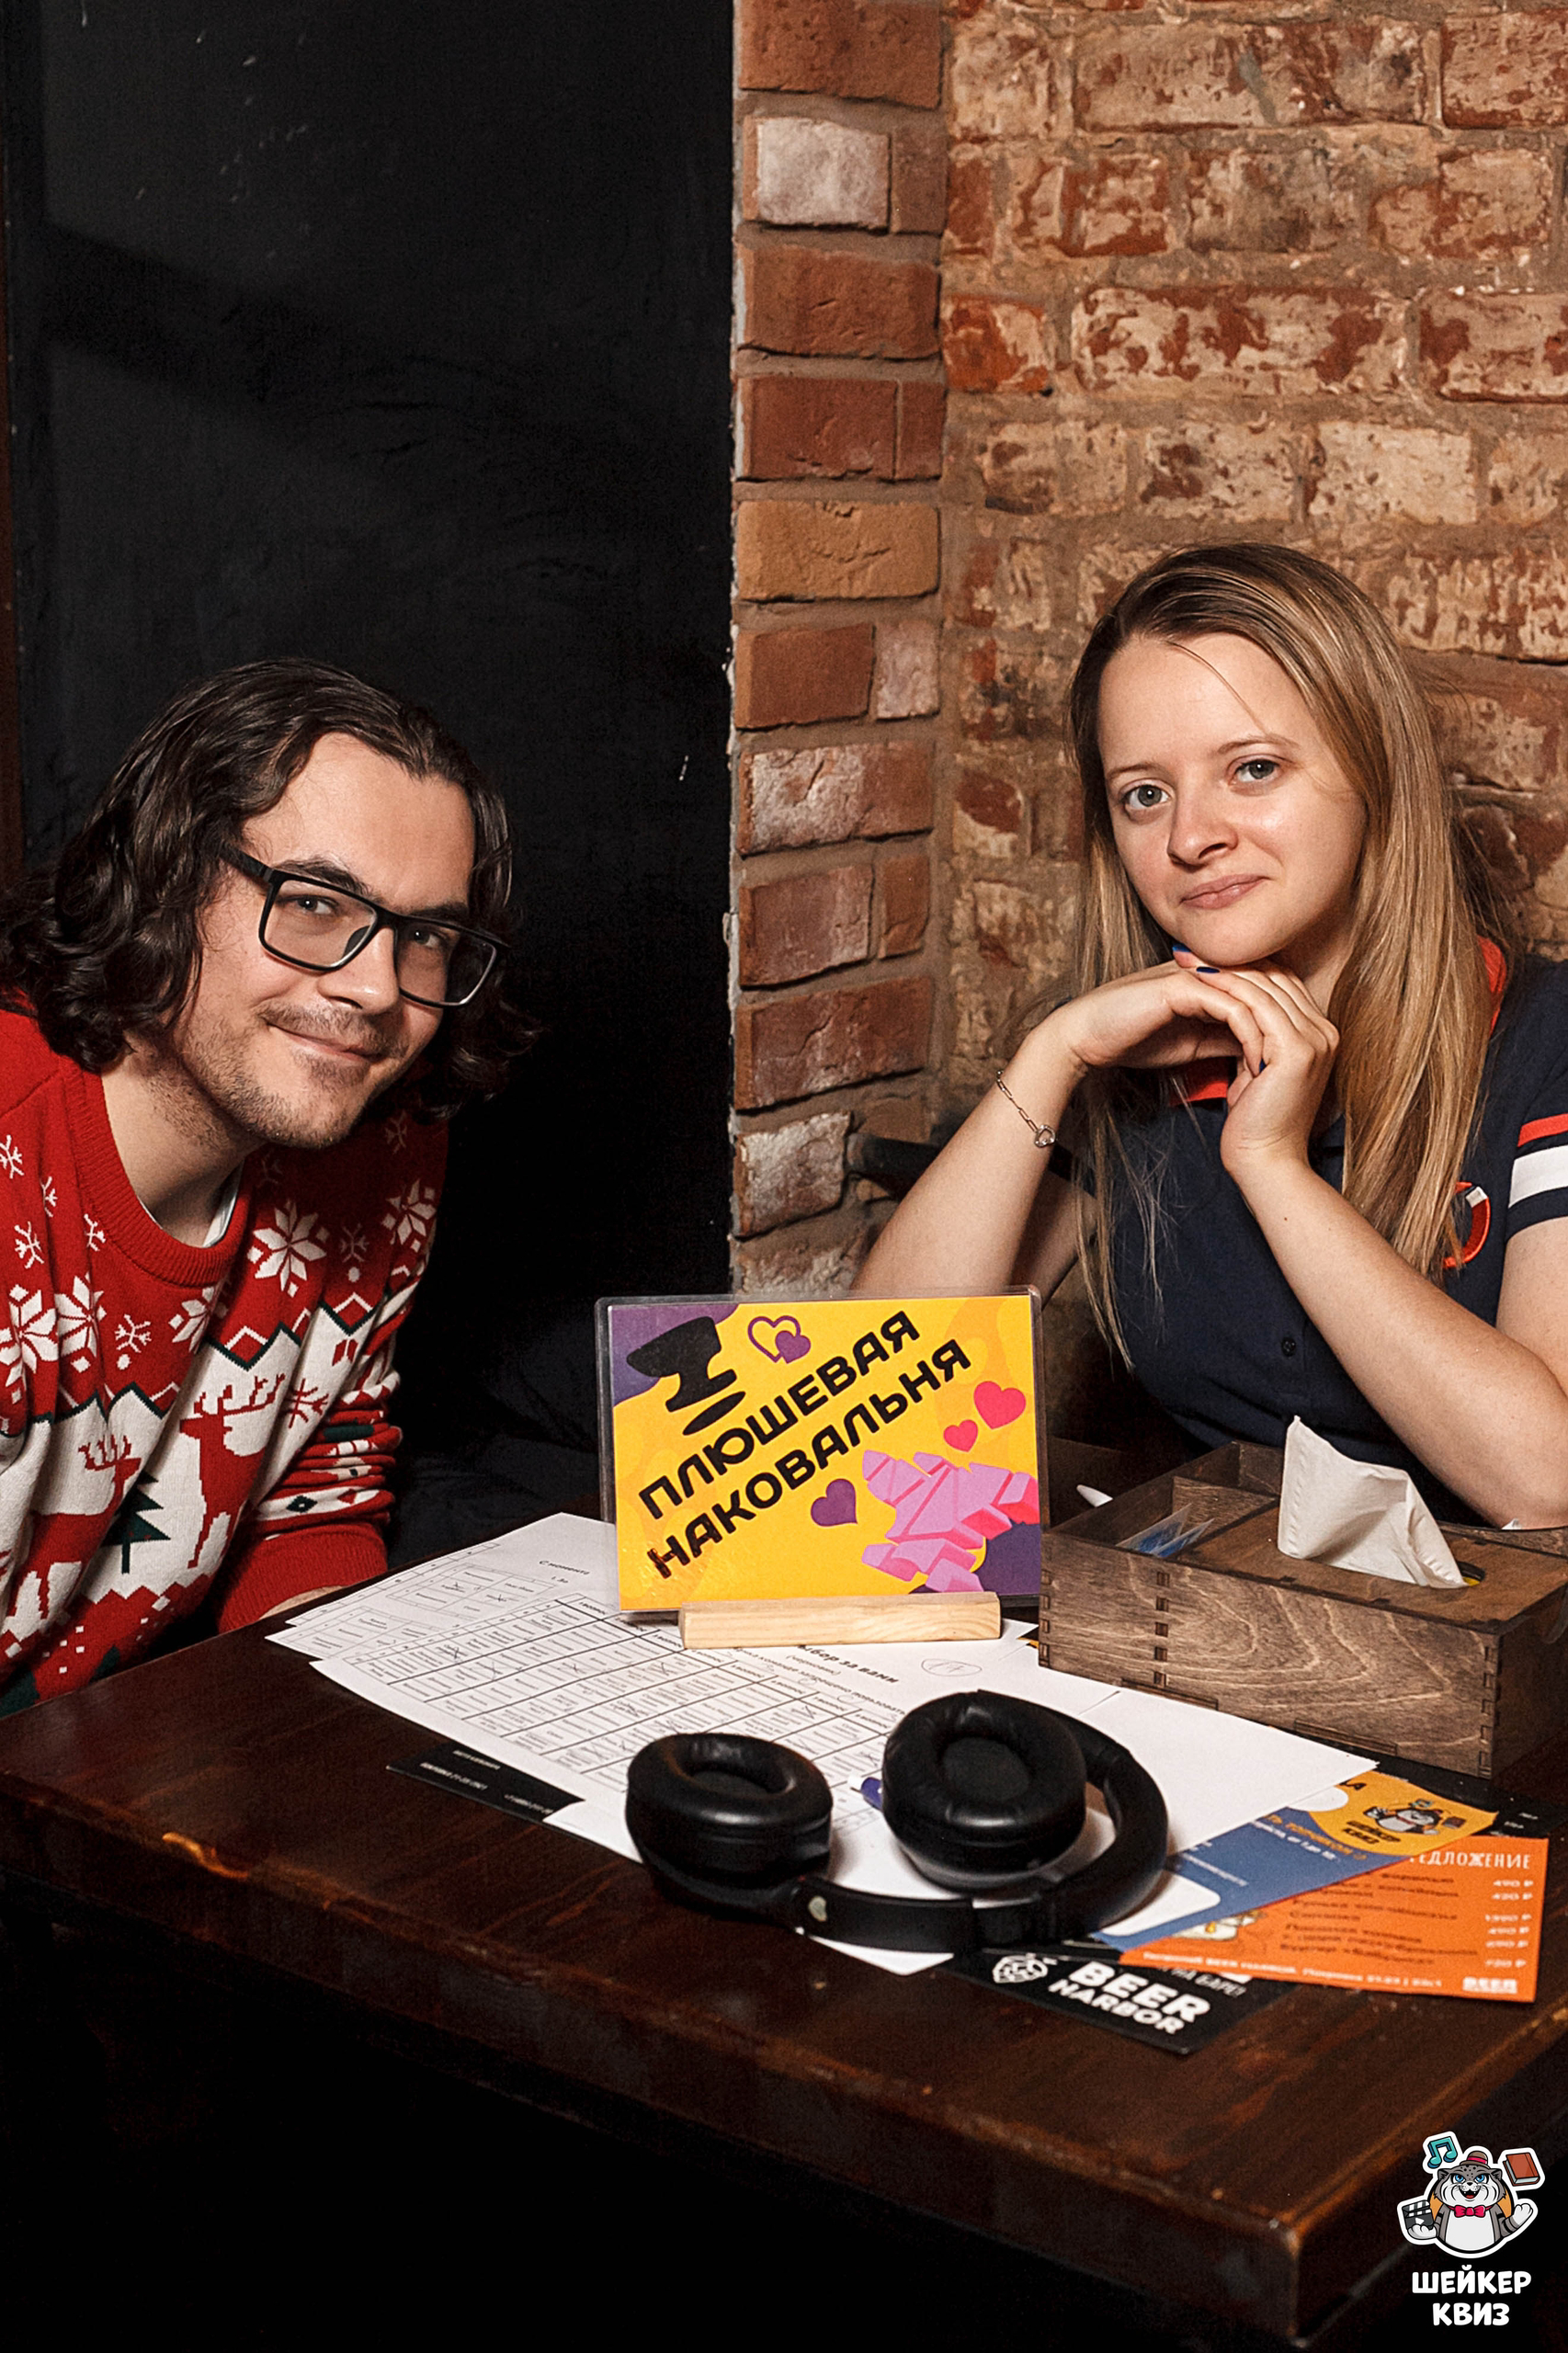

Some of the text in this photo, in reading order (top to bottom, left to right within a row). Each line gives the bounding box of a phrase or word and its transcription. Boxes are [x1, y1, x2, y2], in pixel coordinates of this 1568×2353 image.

[638, 1311, 920, 1519] ПЛЮШЕВАЯ
[646, 1339, 971, 1579] НАКОВАЛЬНЯ
[839, 1661, 858, 1669] за
[858, 1667, 899, 1683] вами
[1410, 1850, 1531, 1870] ЕДЛОЖЕНИЕ
[1048, 1979, 1185, 2035] HARBOR
[1069, 1961, 1210, 2023] BEER
